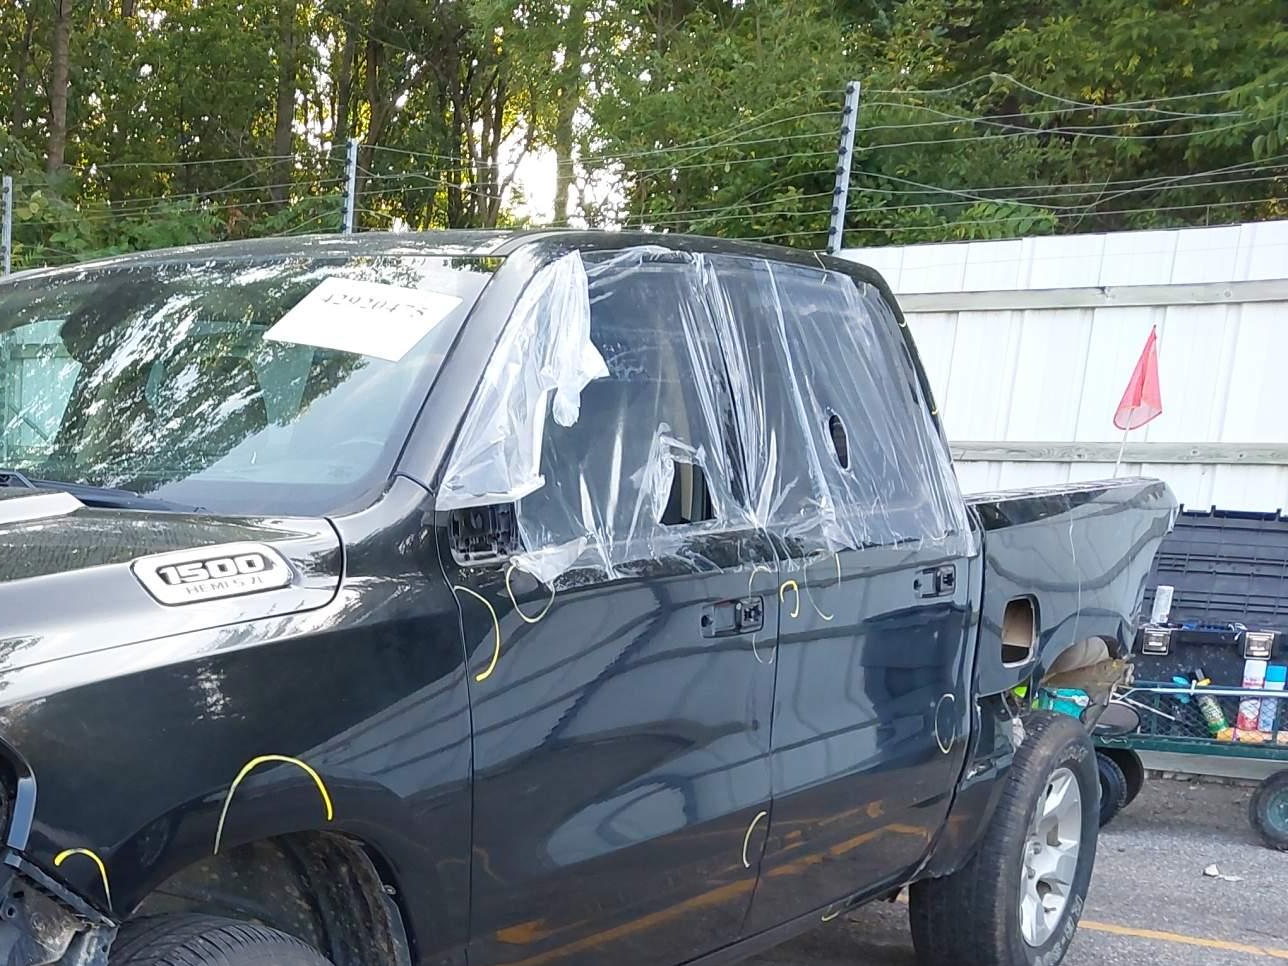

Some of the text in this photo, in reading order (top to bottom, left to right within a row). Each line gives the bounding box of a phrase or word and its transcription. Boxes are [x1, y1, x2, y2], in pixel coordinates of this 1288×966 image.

[158, 552, 266, 586] 1500
[186, 575, 264, 596] HEMI 57L
